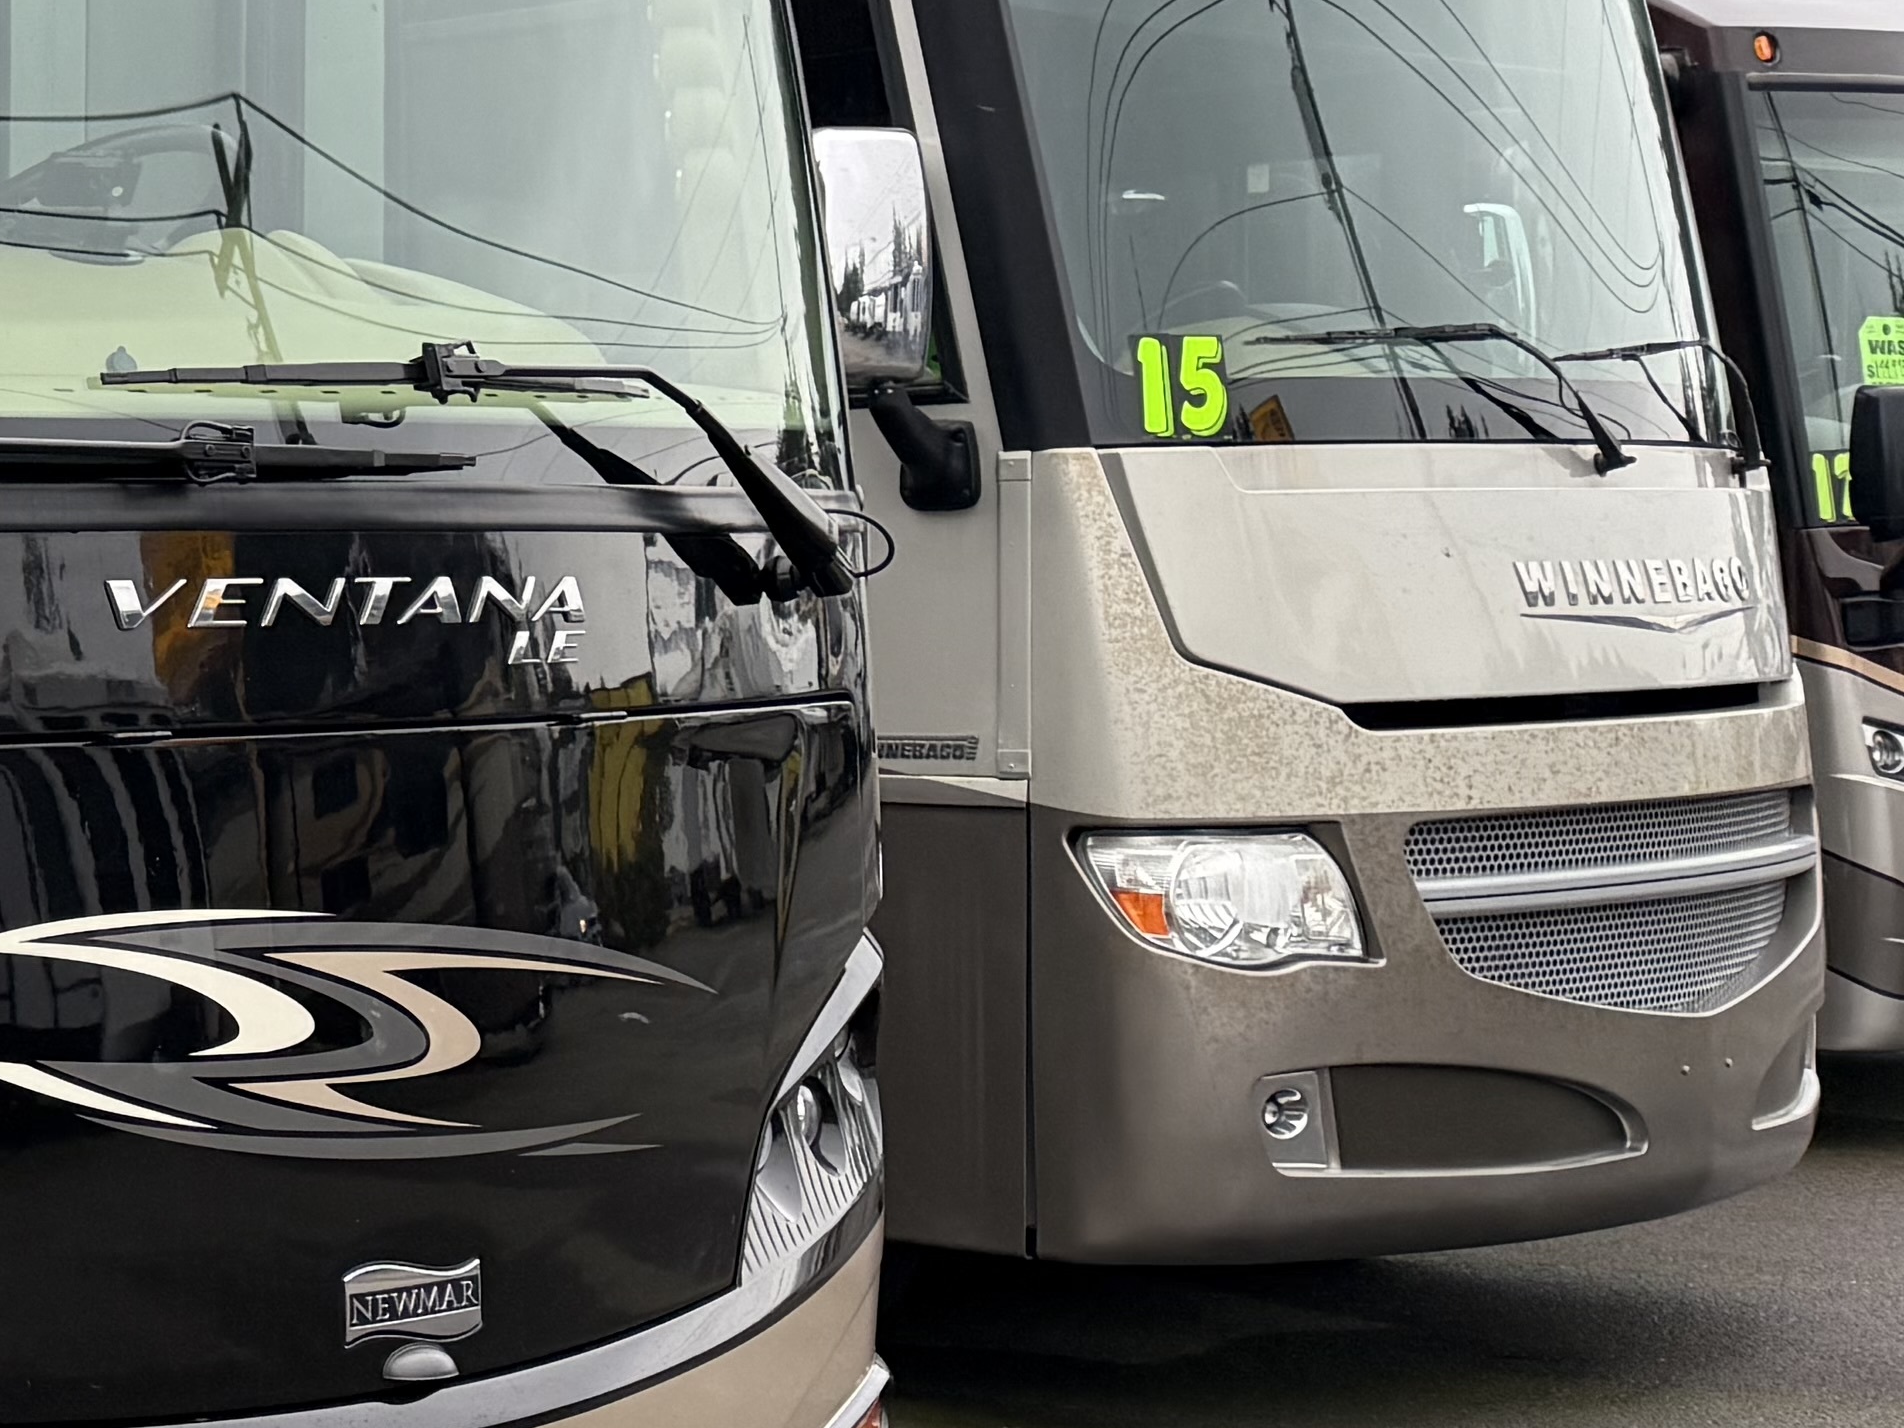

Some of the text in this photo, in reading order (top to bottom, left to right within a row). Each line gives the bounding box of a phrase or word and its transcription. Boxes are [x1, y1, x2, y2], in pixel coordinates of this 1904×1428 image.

[1137, 336, 1228, 437] 15
[103, 575, 586, 631] VENTANA
[1513, 556, 1751, 608] WINNEBAGO
[507, 629, 586, 665] LE
[350, 1279, 479, 1325] NEWMAR
